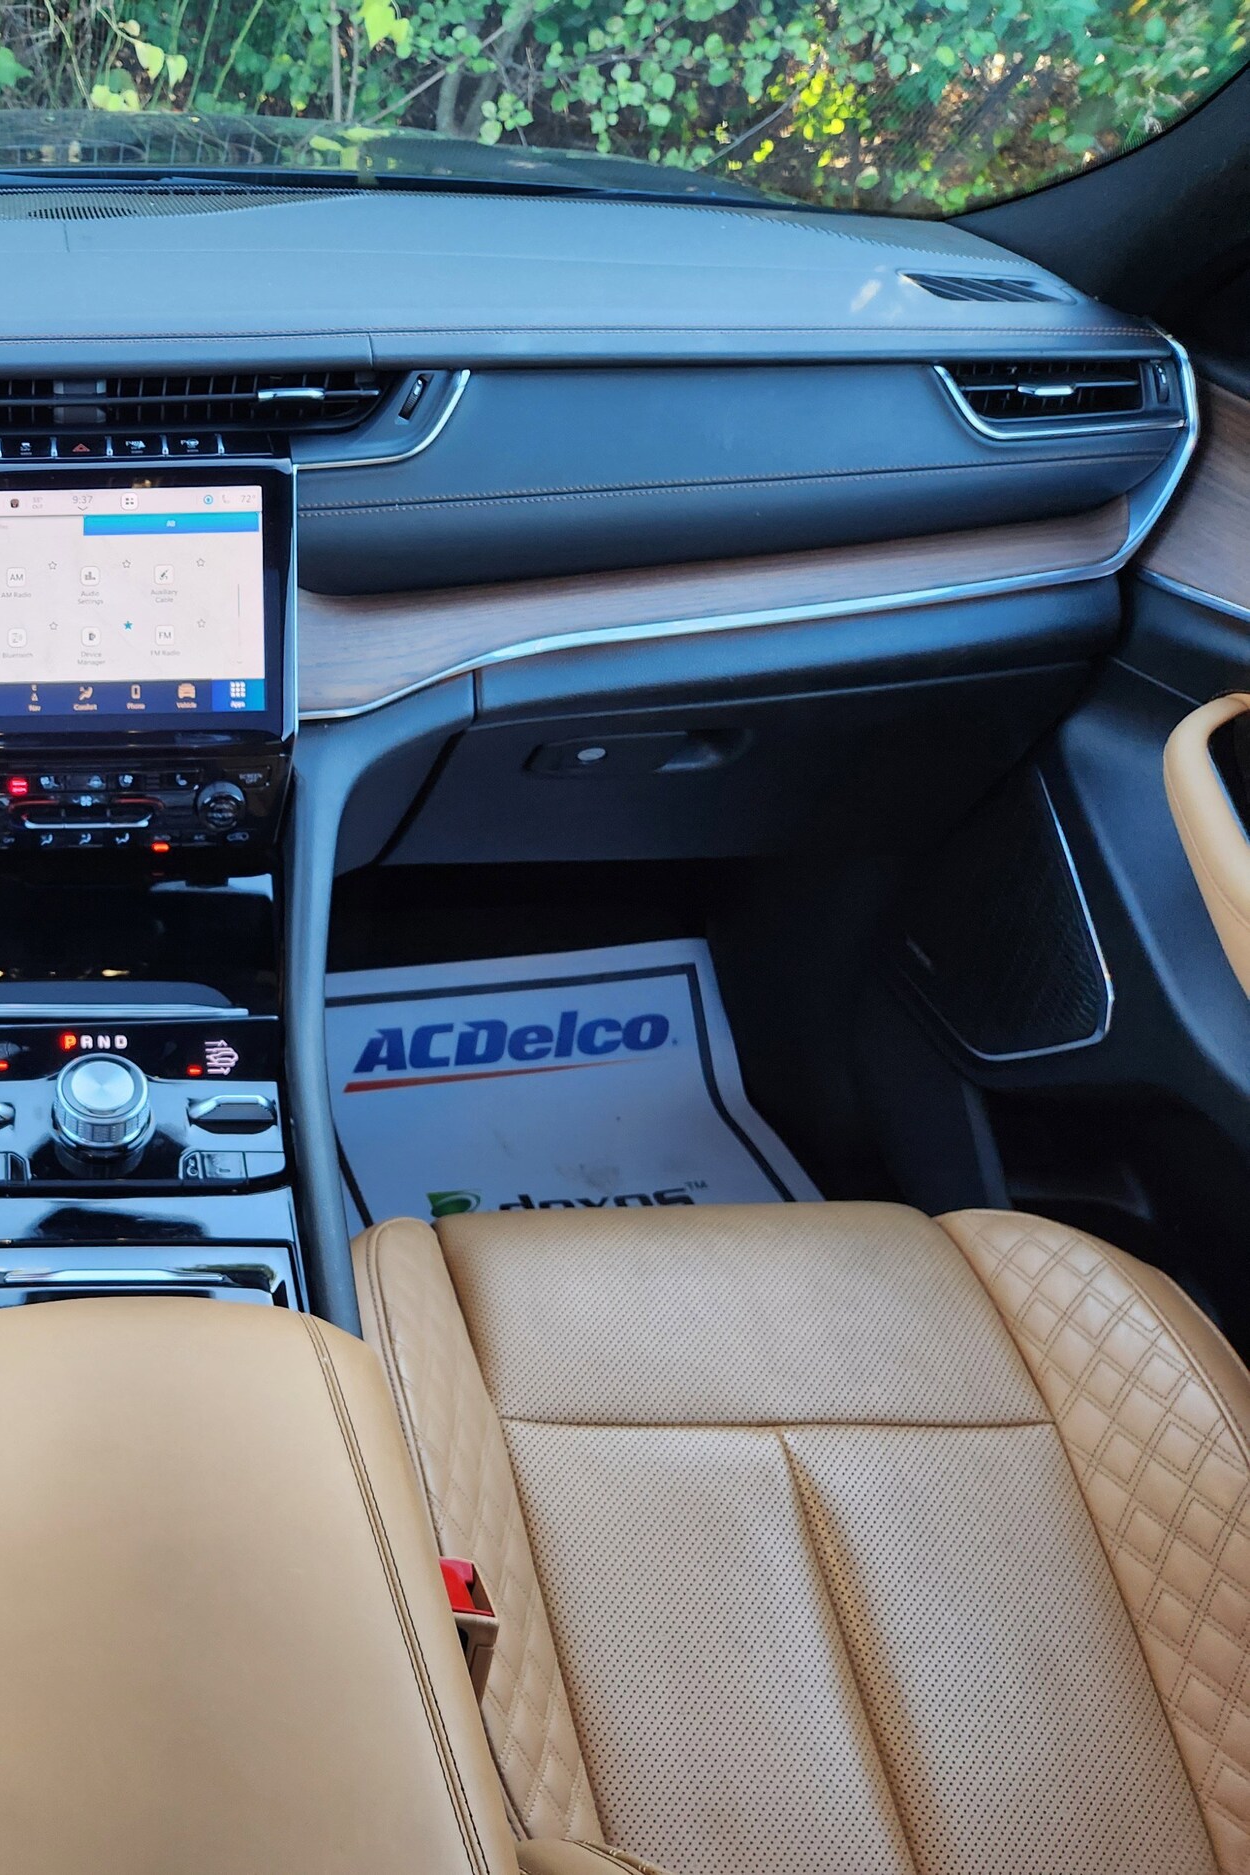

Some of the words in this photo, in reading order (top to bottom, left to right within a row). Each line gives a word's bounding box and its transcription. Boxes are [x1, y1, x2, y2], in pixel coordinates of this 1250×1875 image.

[72, 496, 93, 504] 9:37
[9, 573, 24, 581] AM
[353, 1010, 670, 1073] ACDelco
